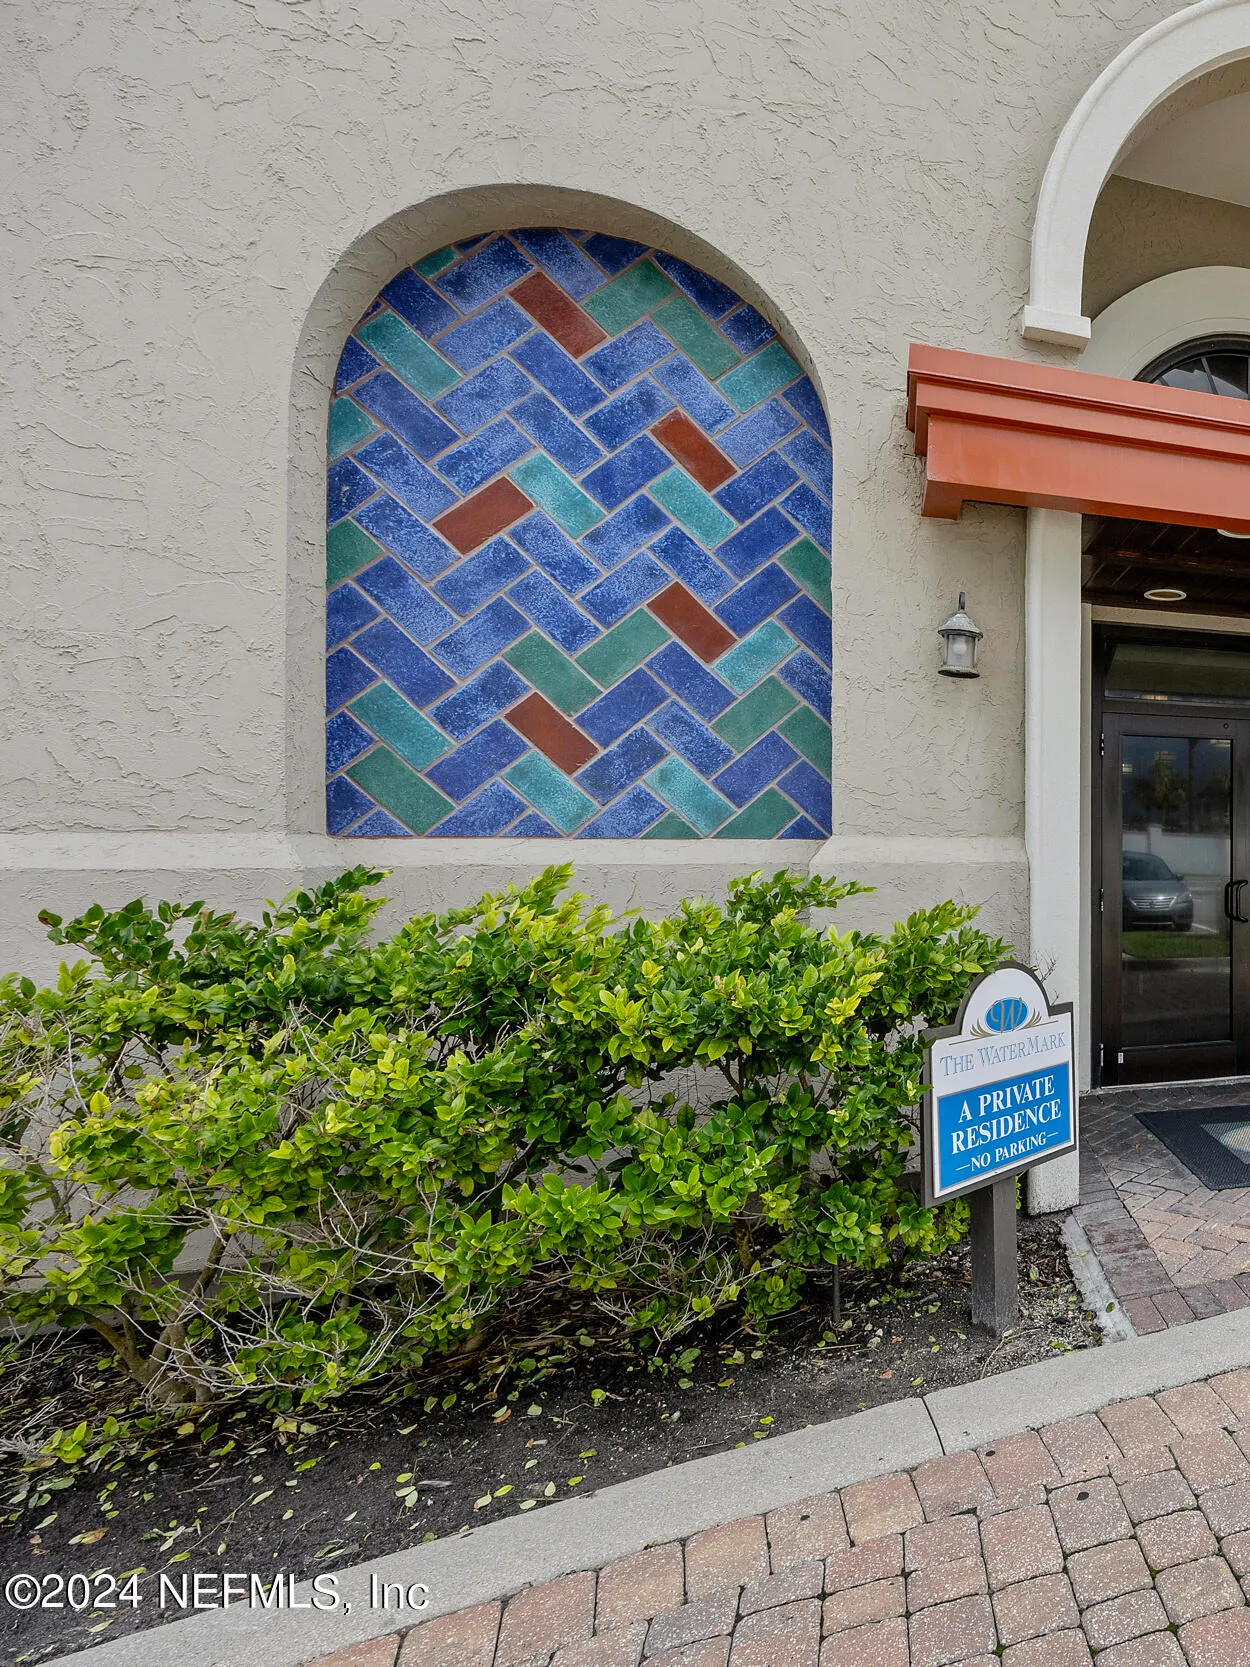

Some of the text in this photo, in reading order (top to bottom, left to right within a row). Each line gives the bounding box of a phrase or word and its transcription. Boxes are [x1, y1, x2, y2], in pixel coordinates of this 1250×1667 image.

[939, 1031, 1066, 1077] THE WATERMARK
[958, 1074, 1055, 1124] A PRIVATE
[951, 1098, 1062, 1155] RESIDENCE
